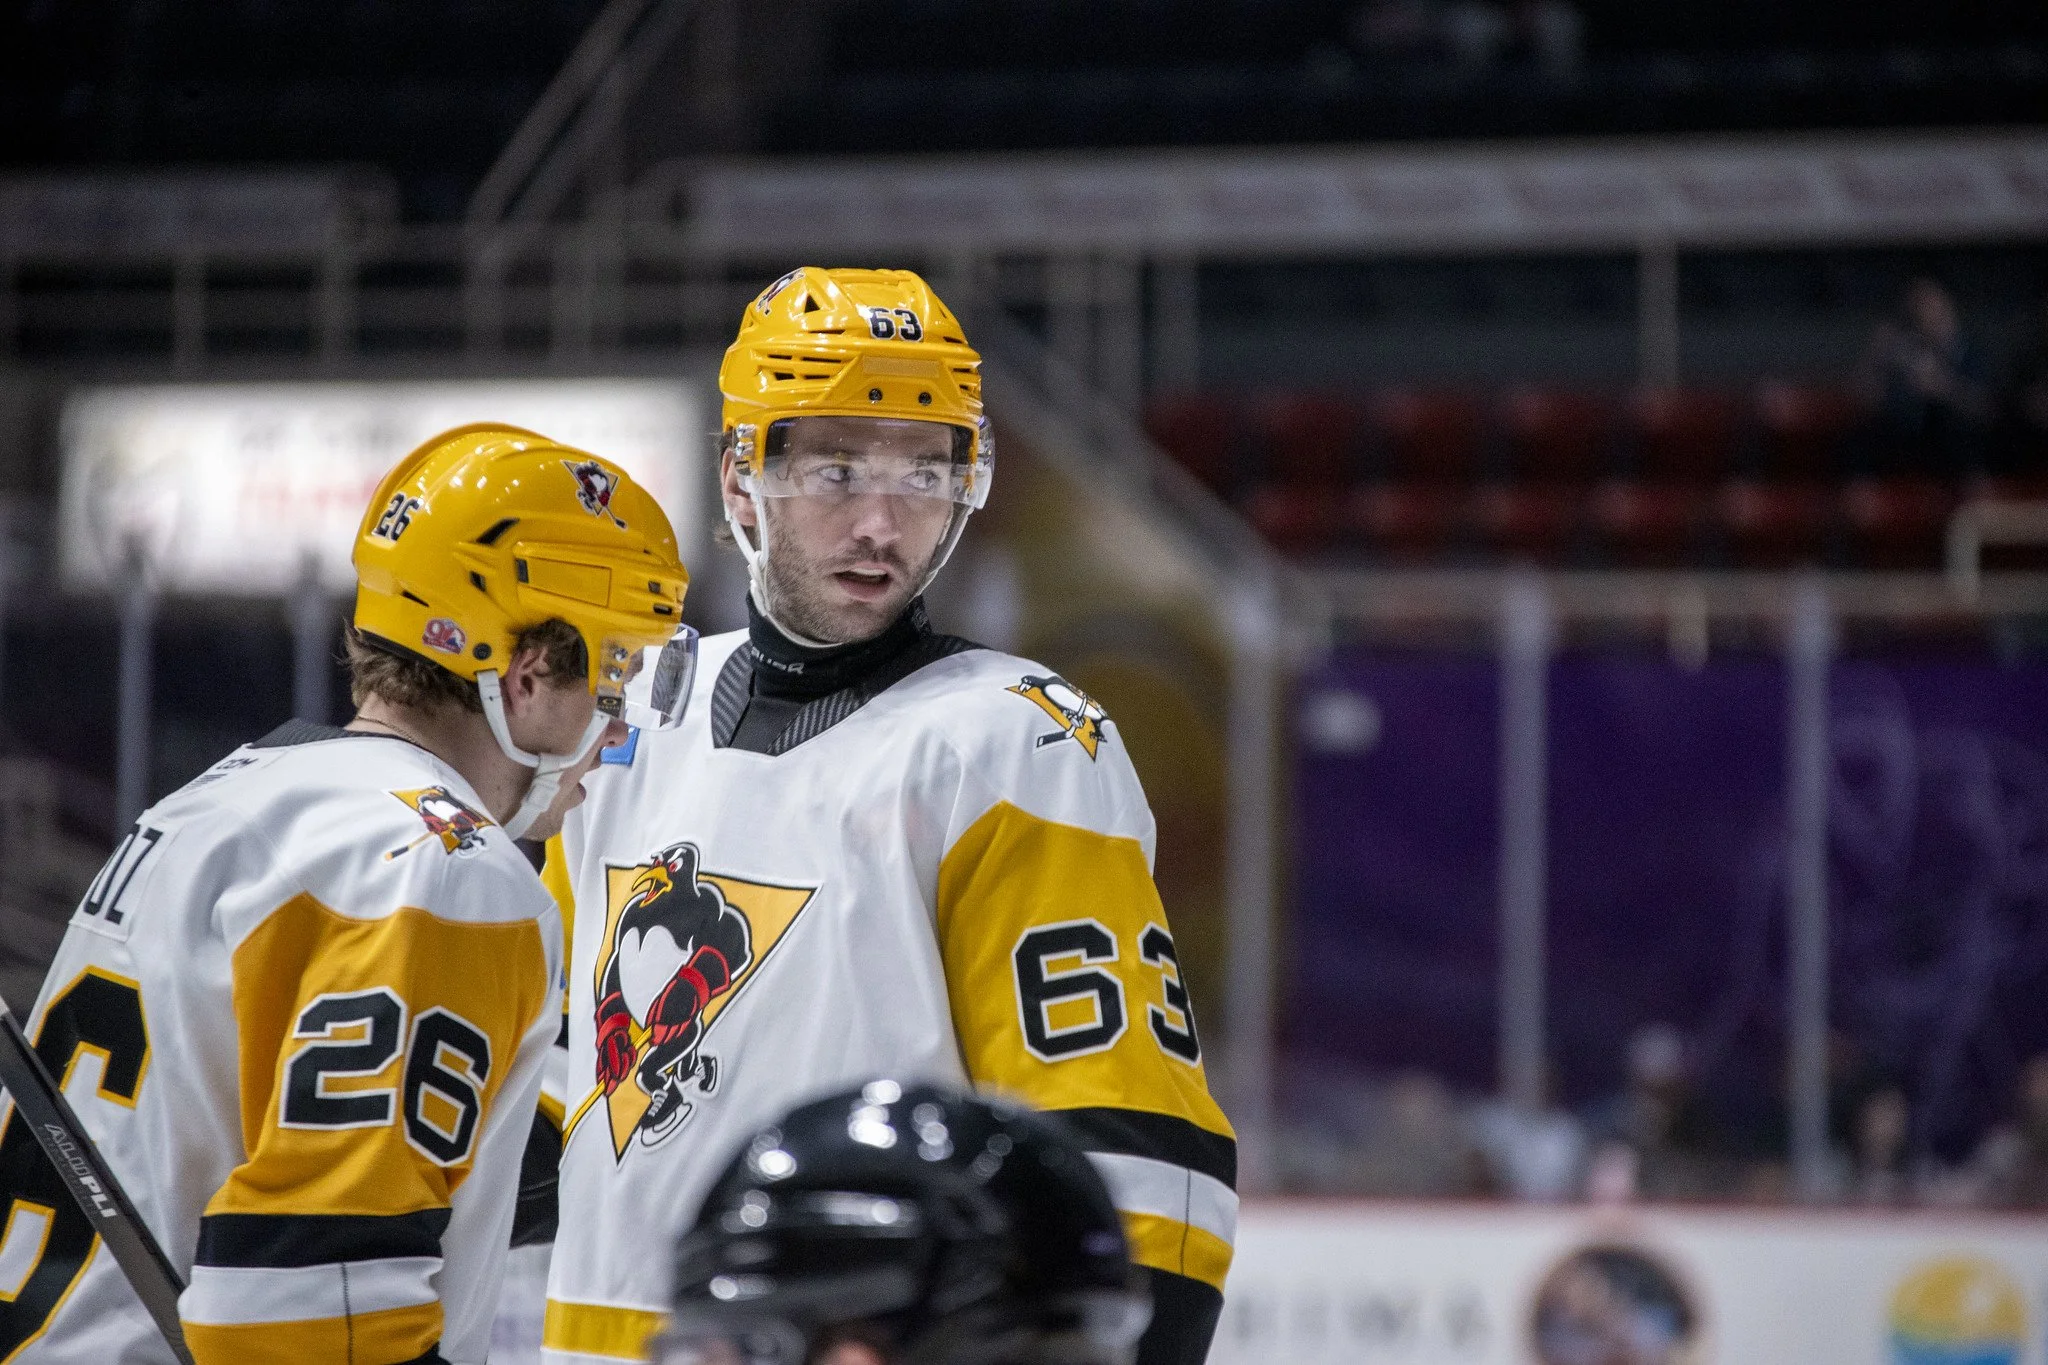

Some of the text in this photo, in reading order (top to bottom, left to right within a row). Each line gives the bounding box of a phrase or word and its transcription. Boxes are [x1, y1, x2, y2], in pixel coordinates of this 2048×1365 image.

[868, 307, 923, 342] 63
[371, 491, 421, 542] 26
[1010, 916, 1202, 1069] 63
[278, 986, 492, 1168] 26
